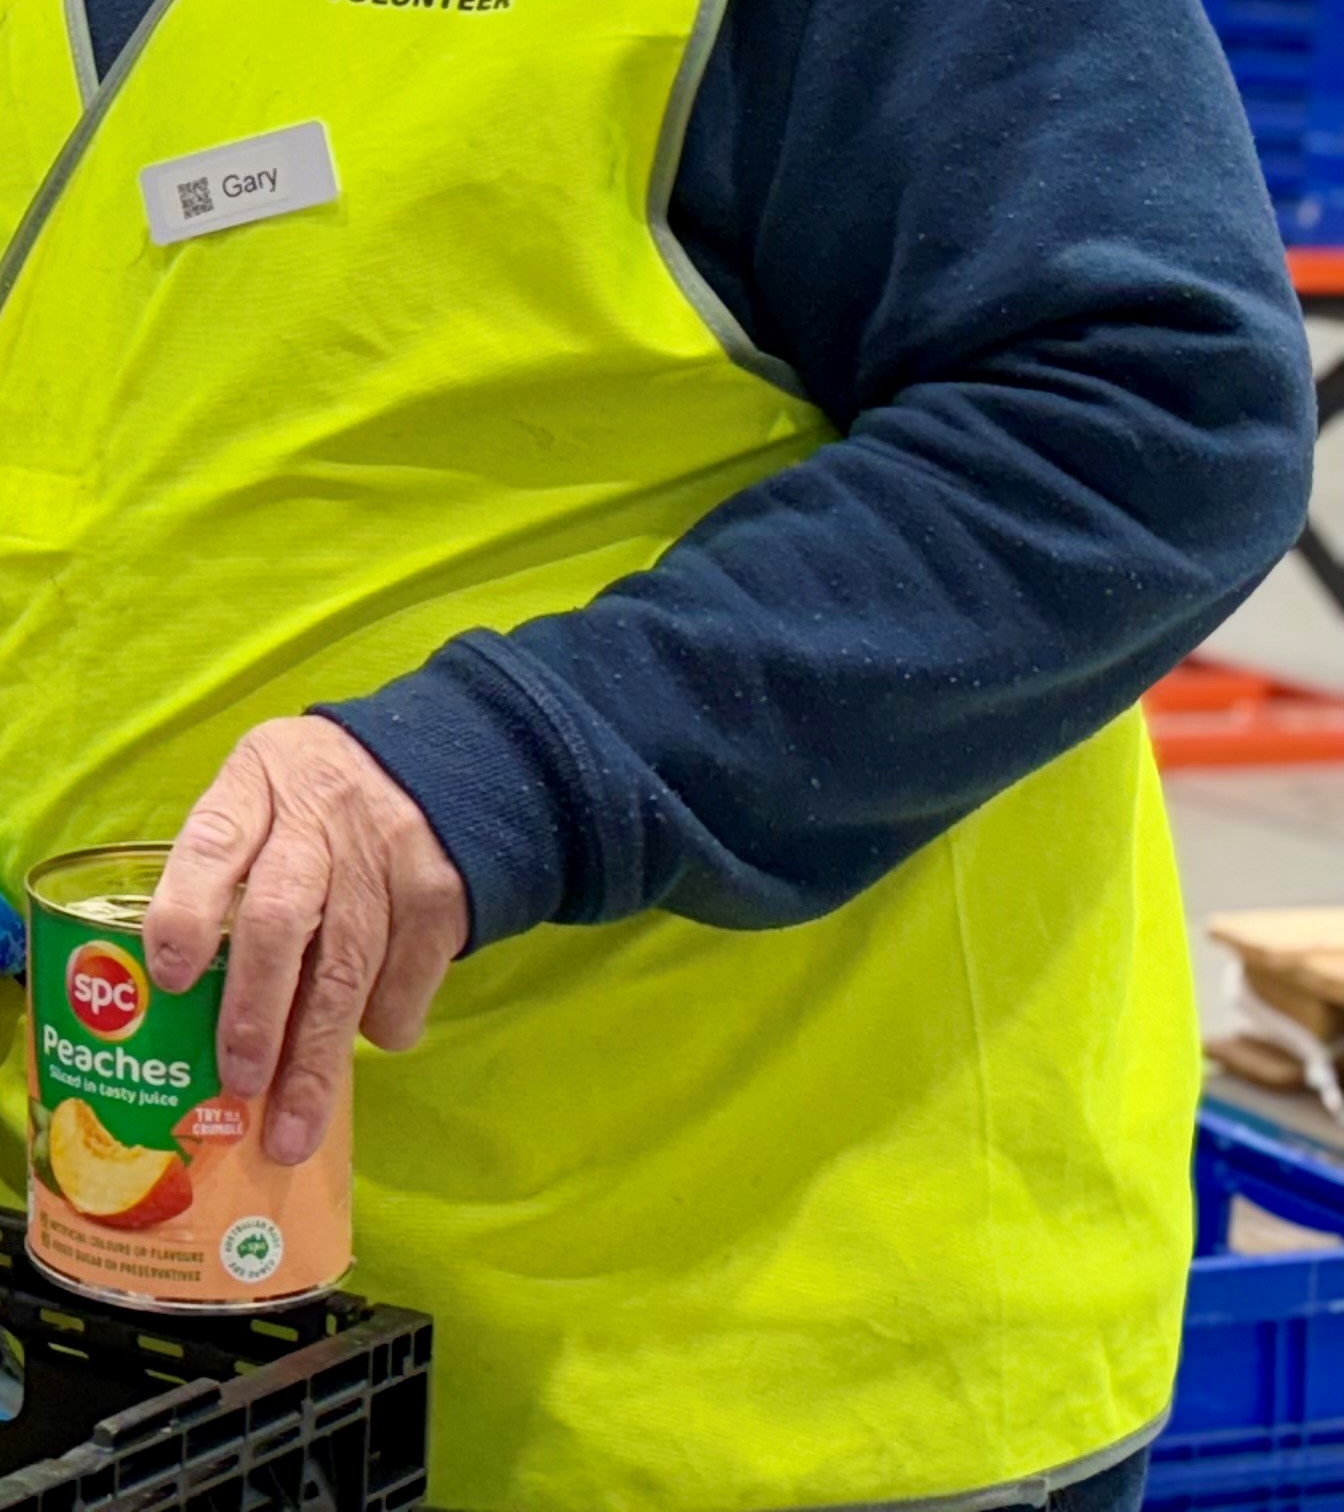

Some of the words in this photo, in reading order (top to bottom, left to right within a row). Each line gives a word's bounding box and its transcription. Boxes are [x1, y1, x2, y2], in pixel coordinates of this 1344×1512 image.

[222, 167, 278, 198] Gary
[73, 973, 135, 1016] spc
[43, 1023, 192, 1089] Peaches
[83, 1076, 97, 1094] in
[98, 1081, 137, 1105] tasty
[138, 1088, 179, 1107] juice
[195, 1107, 223, 1123] TRY
[150, 1247, 205, 1263] FLAVOURS
